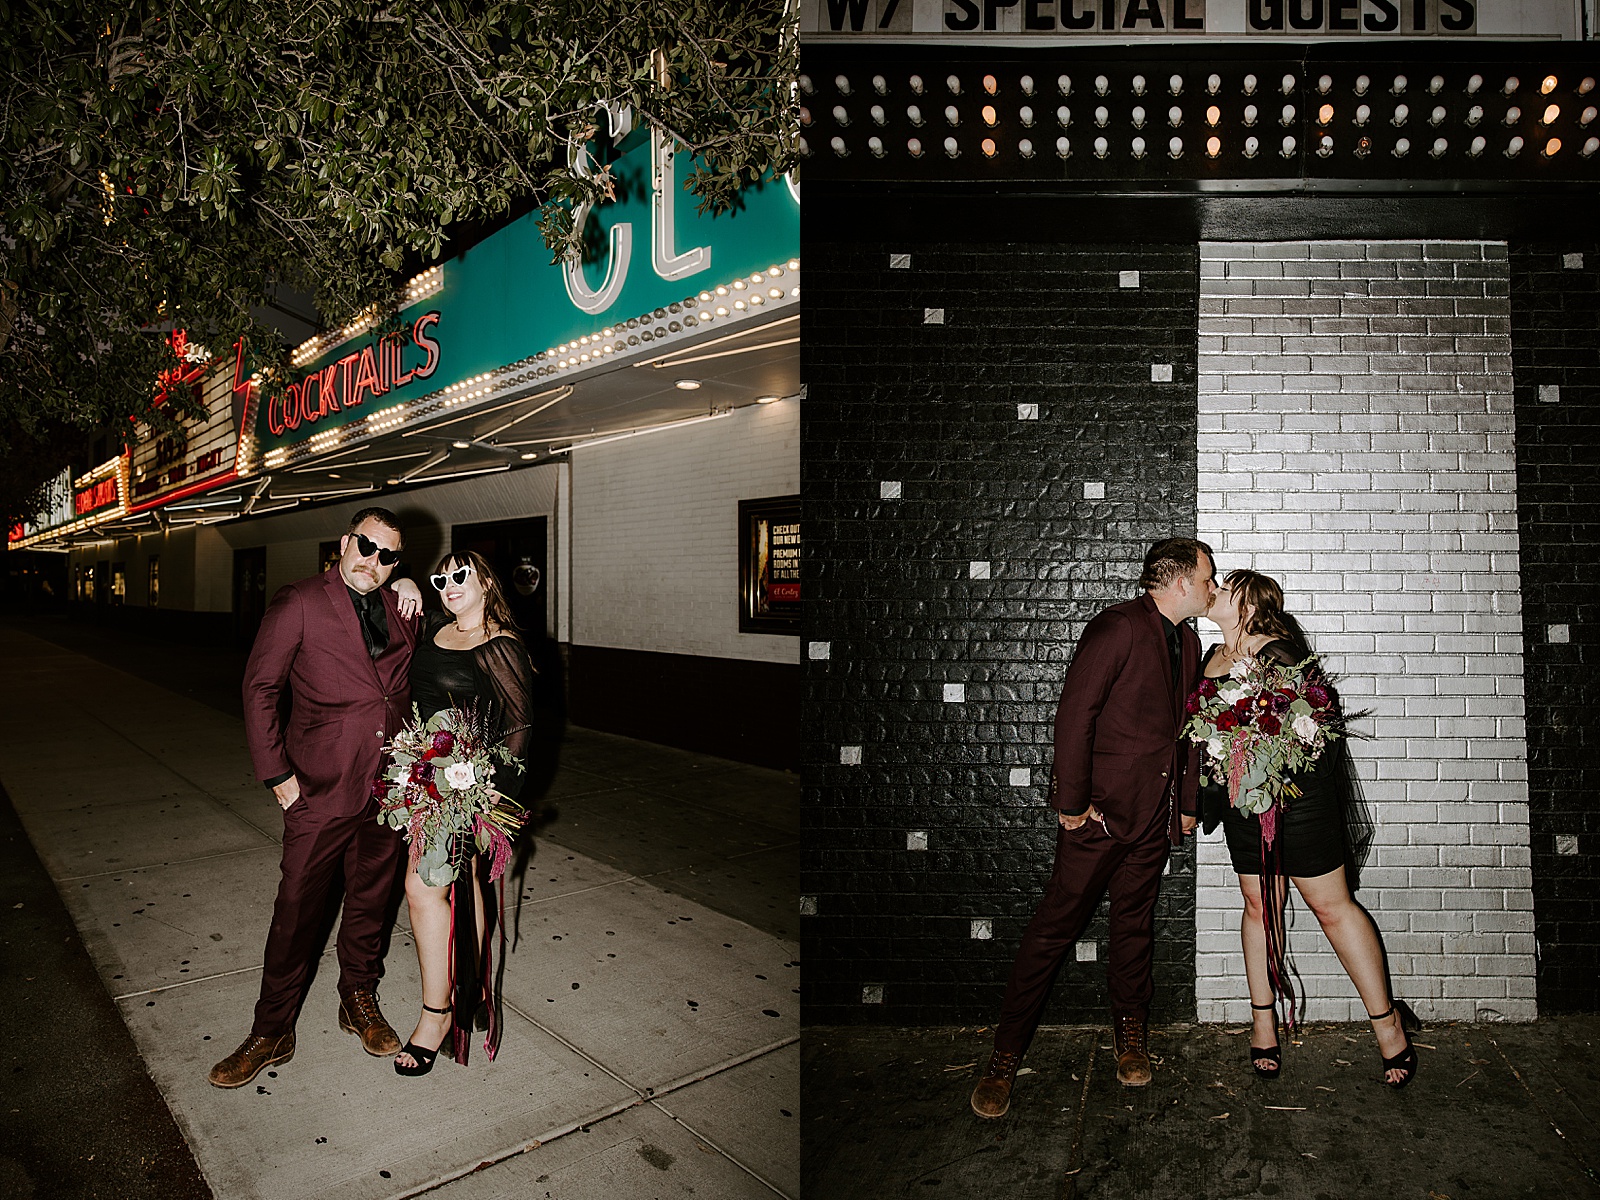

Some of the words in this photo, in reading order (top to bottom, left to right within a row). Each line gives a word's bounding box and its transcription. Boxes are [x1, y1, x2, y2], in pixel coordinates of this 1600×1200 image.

[268, 311, 441, 436] COCKTAILS
[773, 525, 789, 534] CHECK
[790, 524, 800, 533] OUT
[773, 535, 783, 545] OUR
[784, 535, 796, 544] NEW
[773, 549, 797, 558] PREMIUM
[773, 560, 791, 568] ROOMS
[792, 560, 799, 568] IN
[773, 570, 780, 578] OF
[780, 570, 789, 578] ALL
[790, 569, 800, 578] THE
